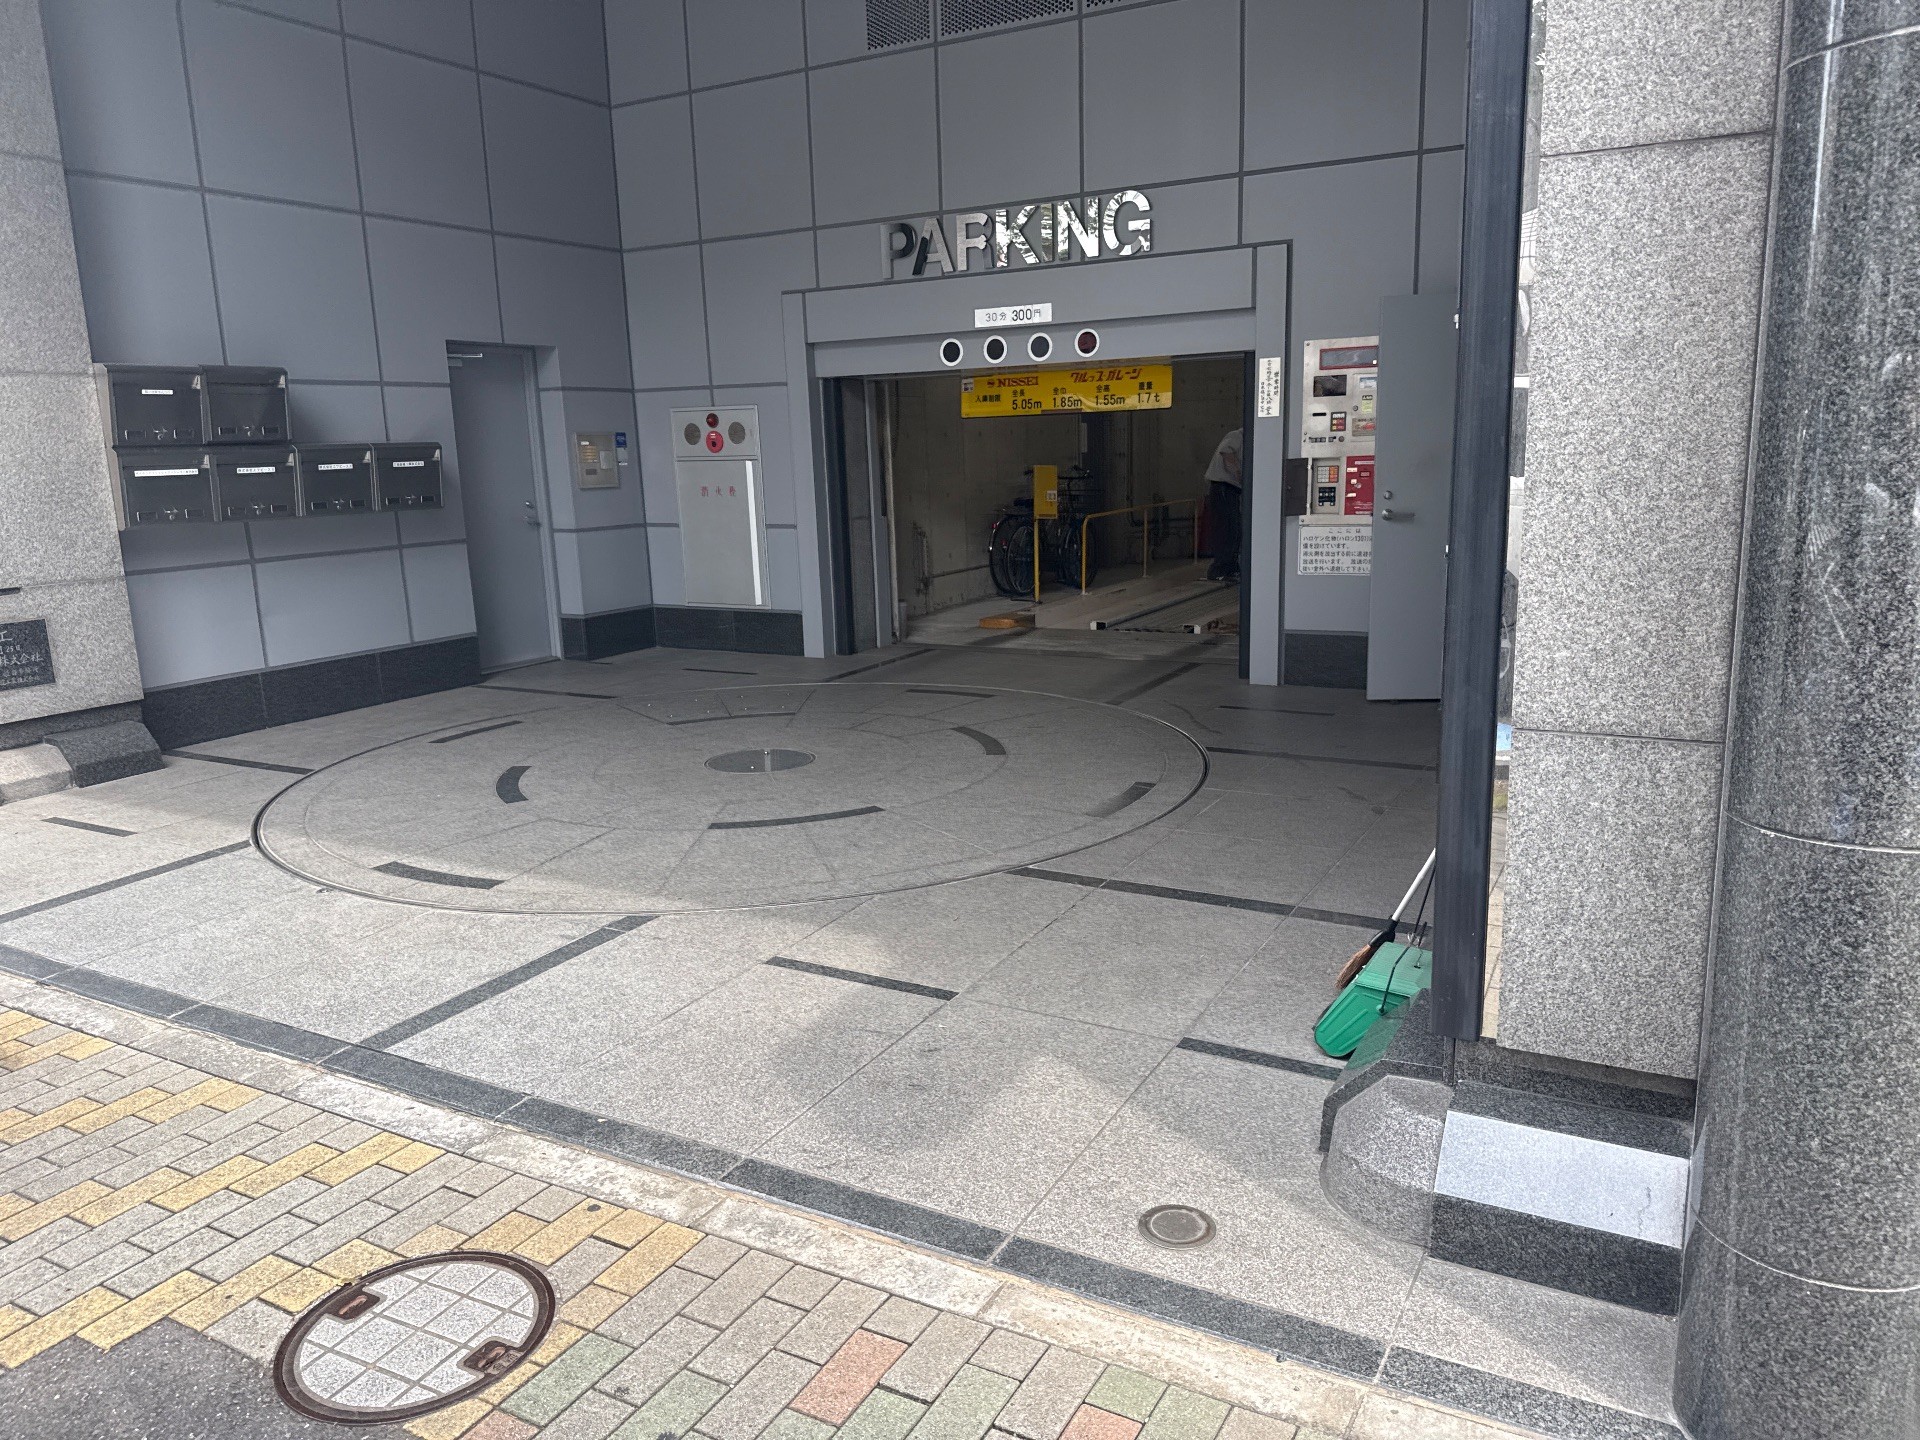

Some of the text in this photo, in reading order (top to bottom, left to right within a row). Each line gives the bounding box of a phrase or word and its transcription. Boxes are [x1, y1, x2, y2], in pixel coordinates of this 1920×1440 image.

[880, 190, 1151, 279] PARKING
[985, 309, 1041, 322] 30分 300円
[997, 376, 1038, 388] NISSEI
[1012, 398, 1042, 410] 5.05m
[1053, 395, 1082, 408] 1.85m
[1095, 394, 1125, 406] 1.55m
